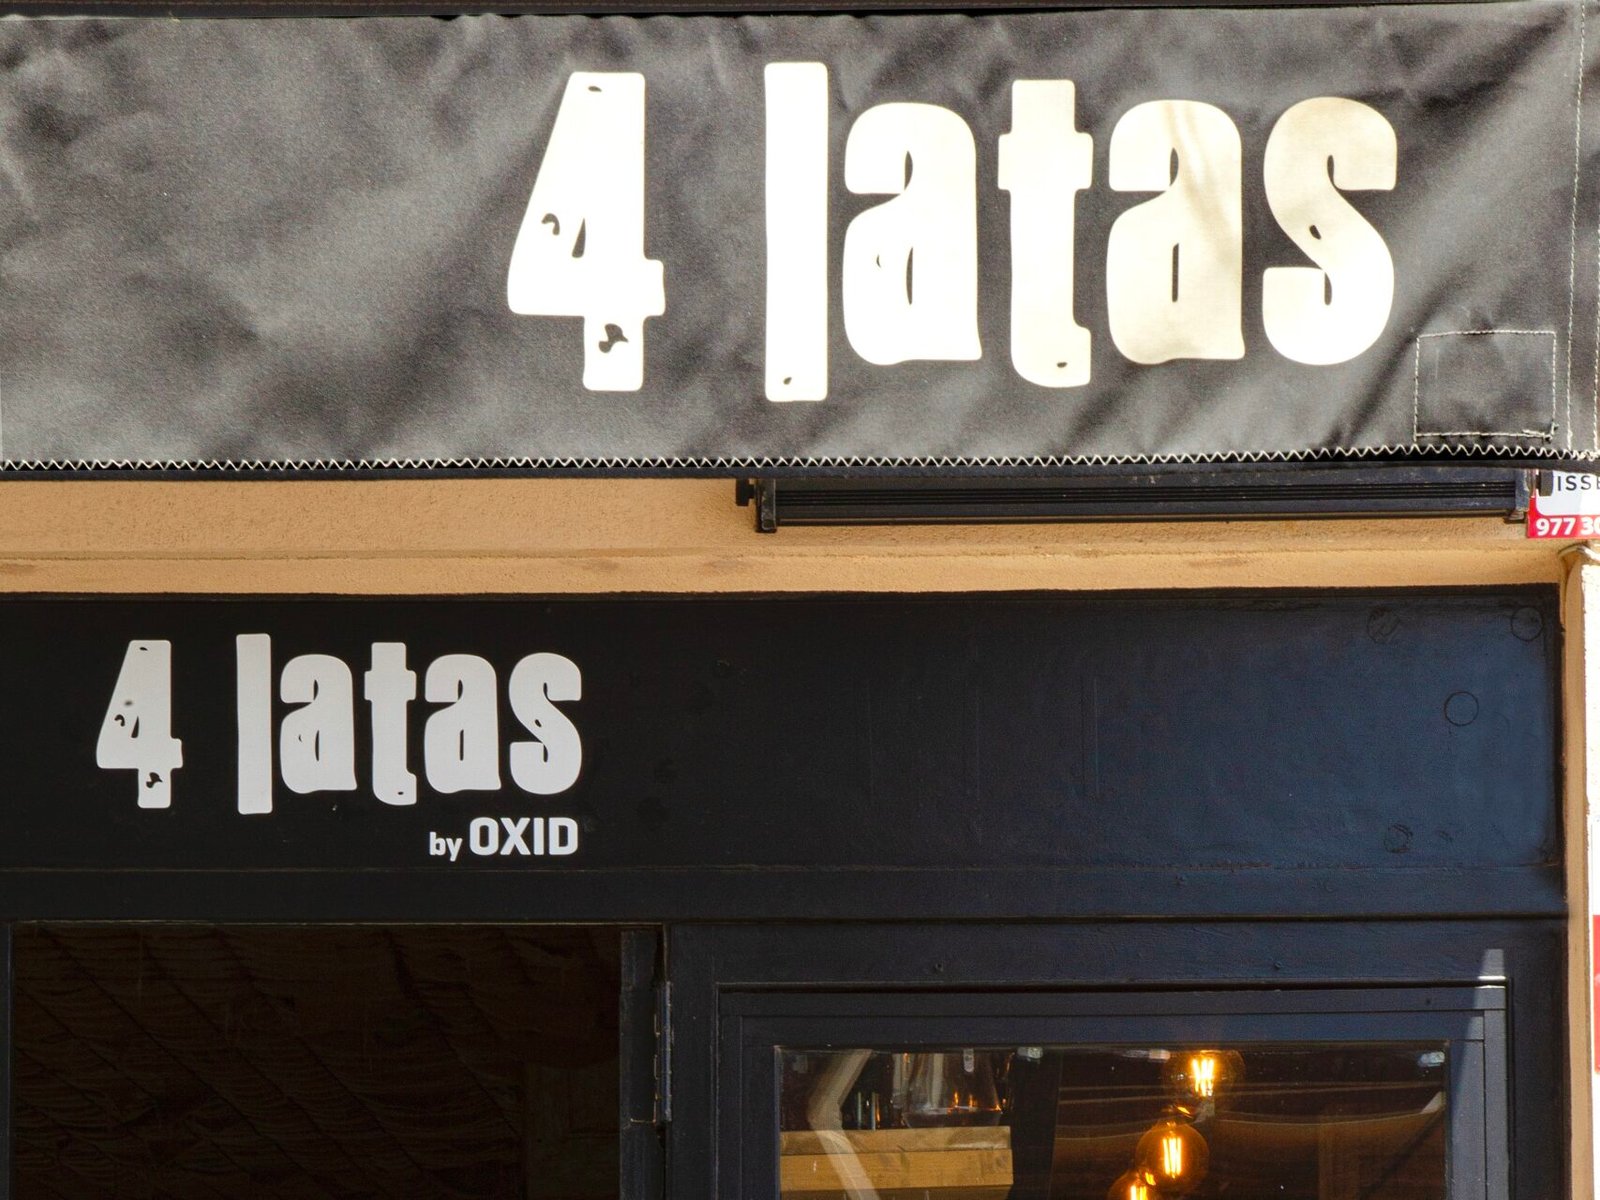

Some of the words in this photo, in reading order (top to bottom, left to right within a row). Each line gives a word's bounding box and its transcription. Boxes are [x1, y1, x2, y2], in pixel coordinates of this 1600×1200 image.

[507, 71, 667, 393] 4
[763, 61, 1400, 403] latas
[1535, 518, 1576, 537] 977
[95, 639, 184, 809] 4
[235, 633, 583, 815] latas
[429, 831, 463, 862] by
[469, 816, 579, 857] OXID
